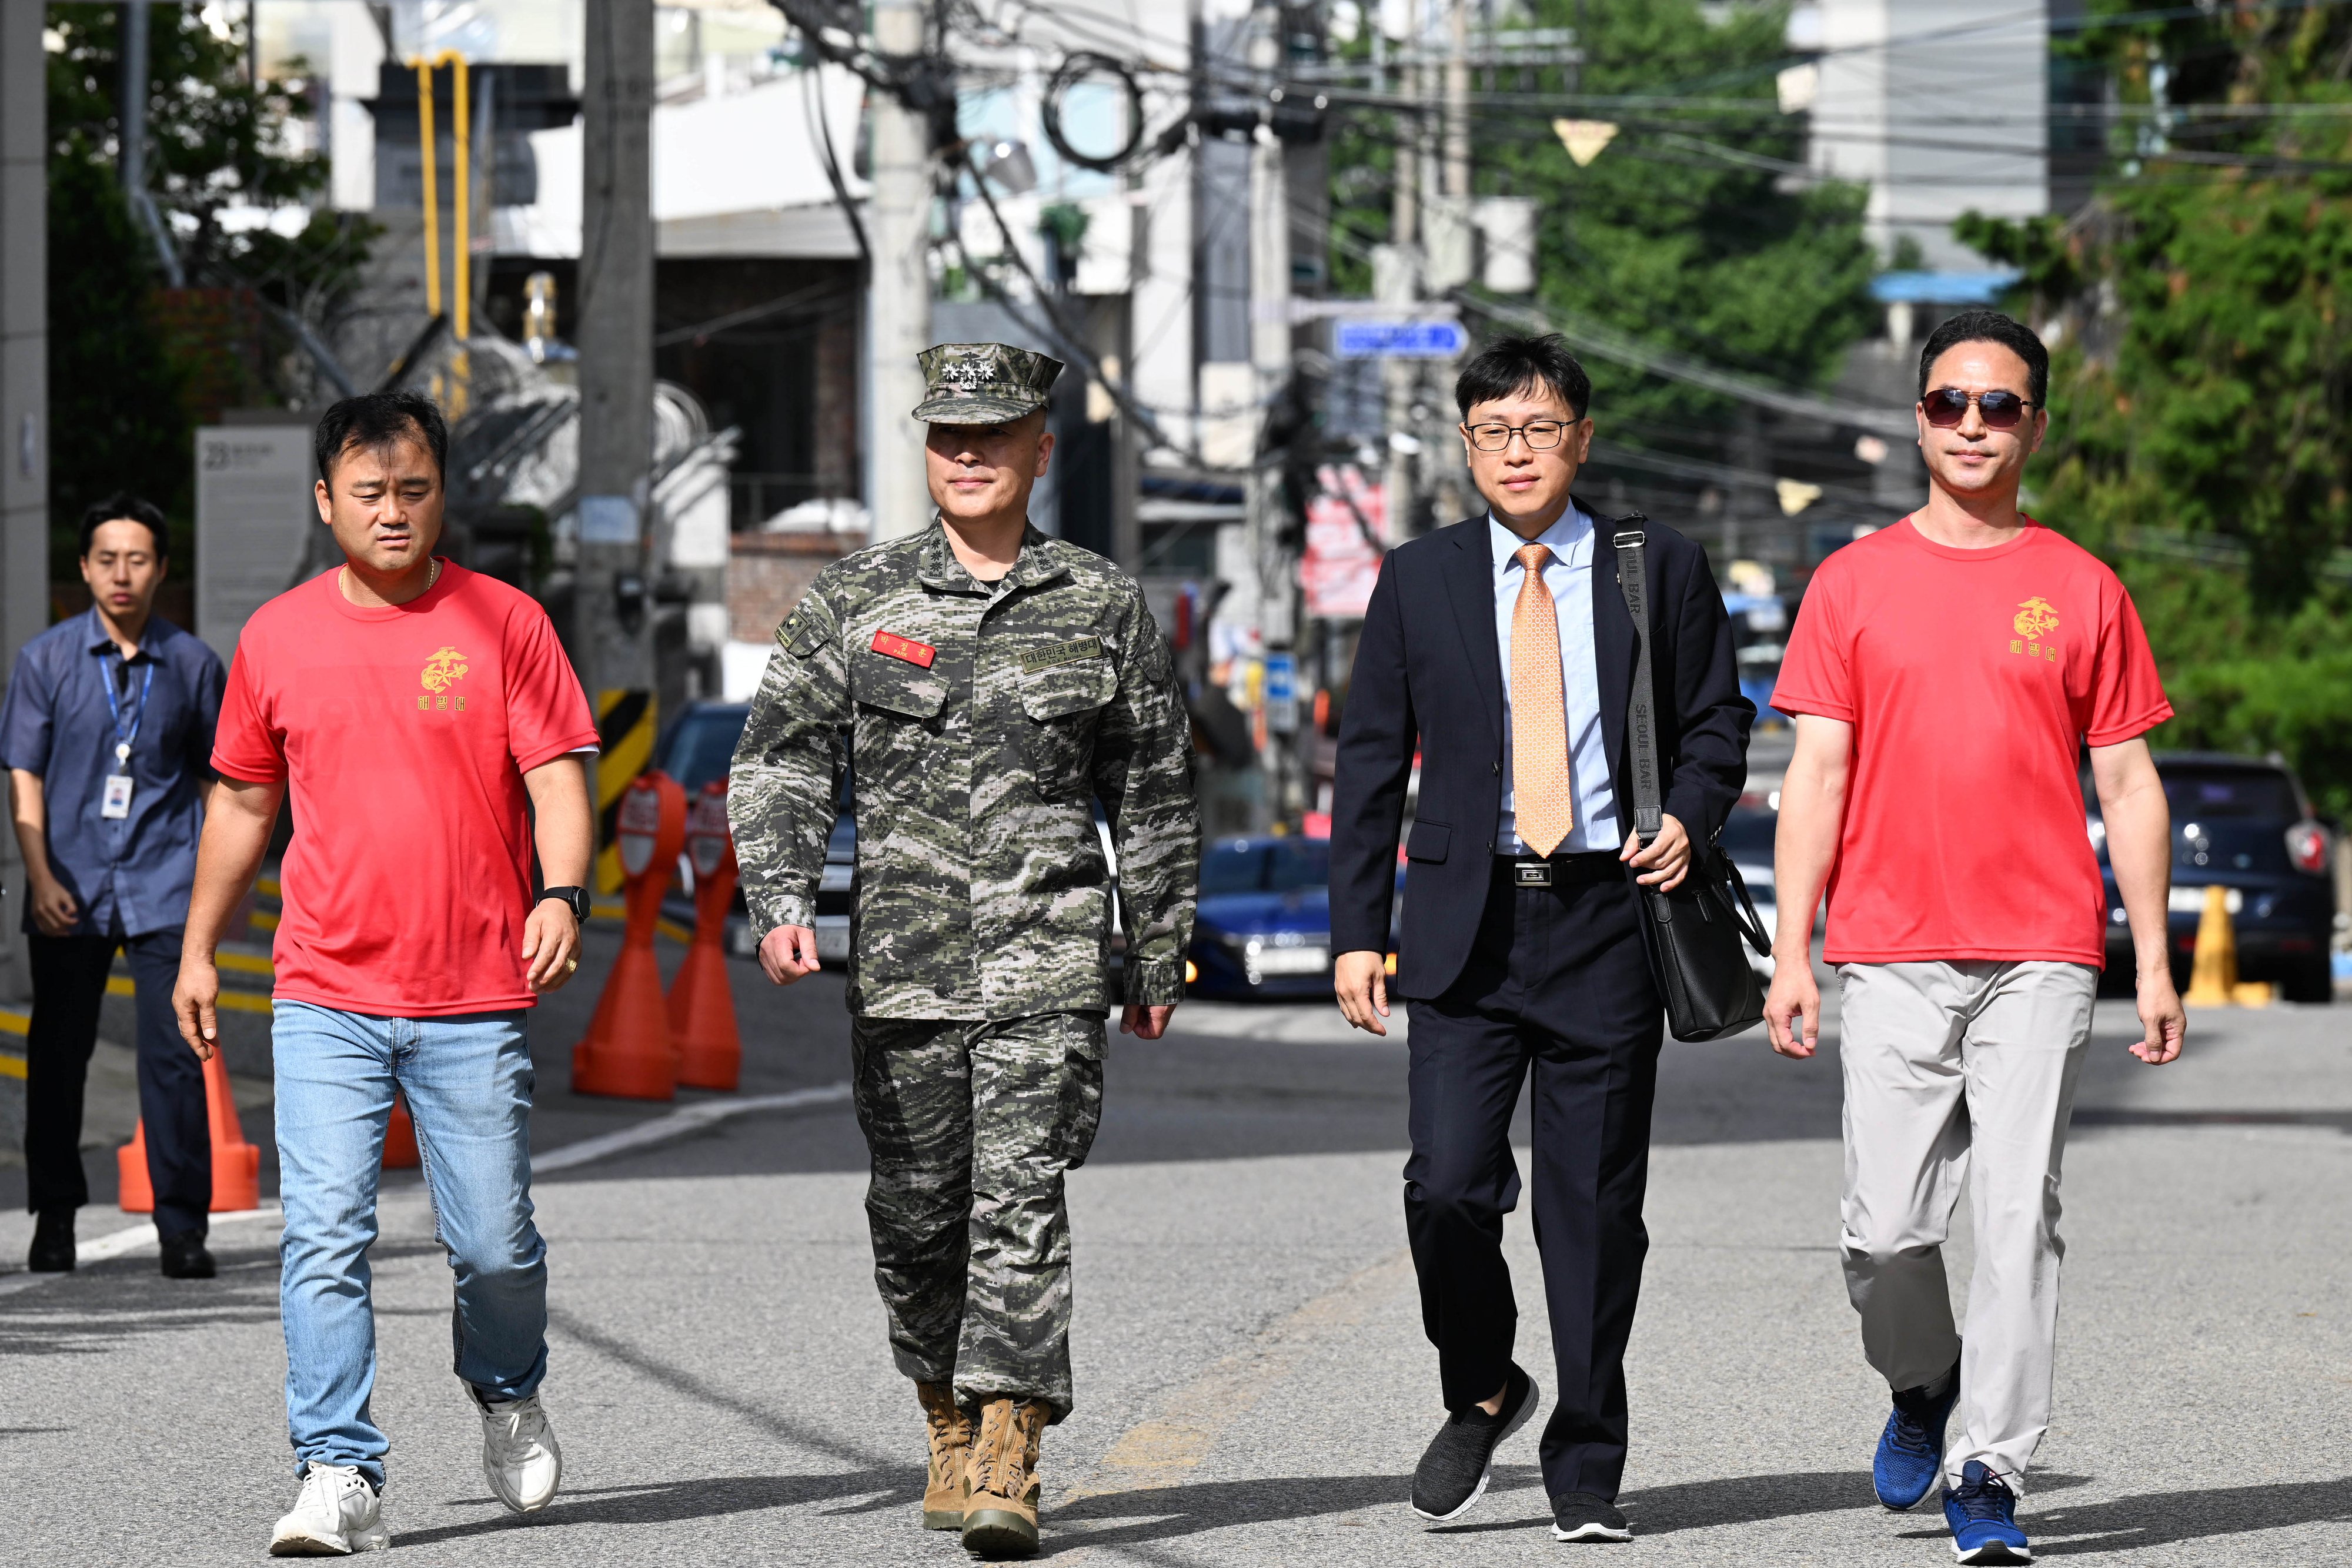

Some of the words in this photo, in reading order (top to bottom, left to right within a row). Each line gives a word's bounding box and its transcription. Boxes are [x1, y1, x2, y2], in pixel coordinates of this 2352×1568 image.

[1623, 534, 1638, 579] SOUL
[1628, 583, 1641, 614] BAR
[893, 649, 908, 658] PARK
[1025, 646, 1066, 663] 대한민국
[1068, 638, 1098, 653] 해병대
[1636, 704, 1649, 754] SEOUL
[1639, 758, 1652, 790] BAR
